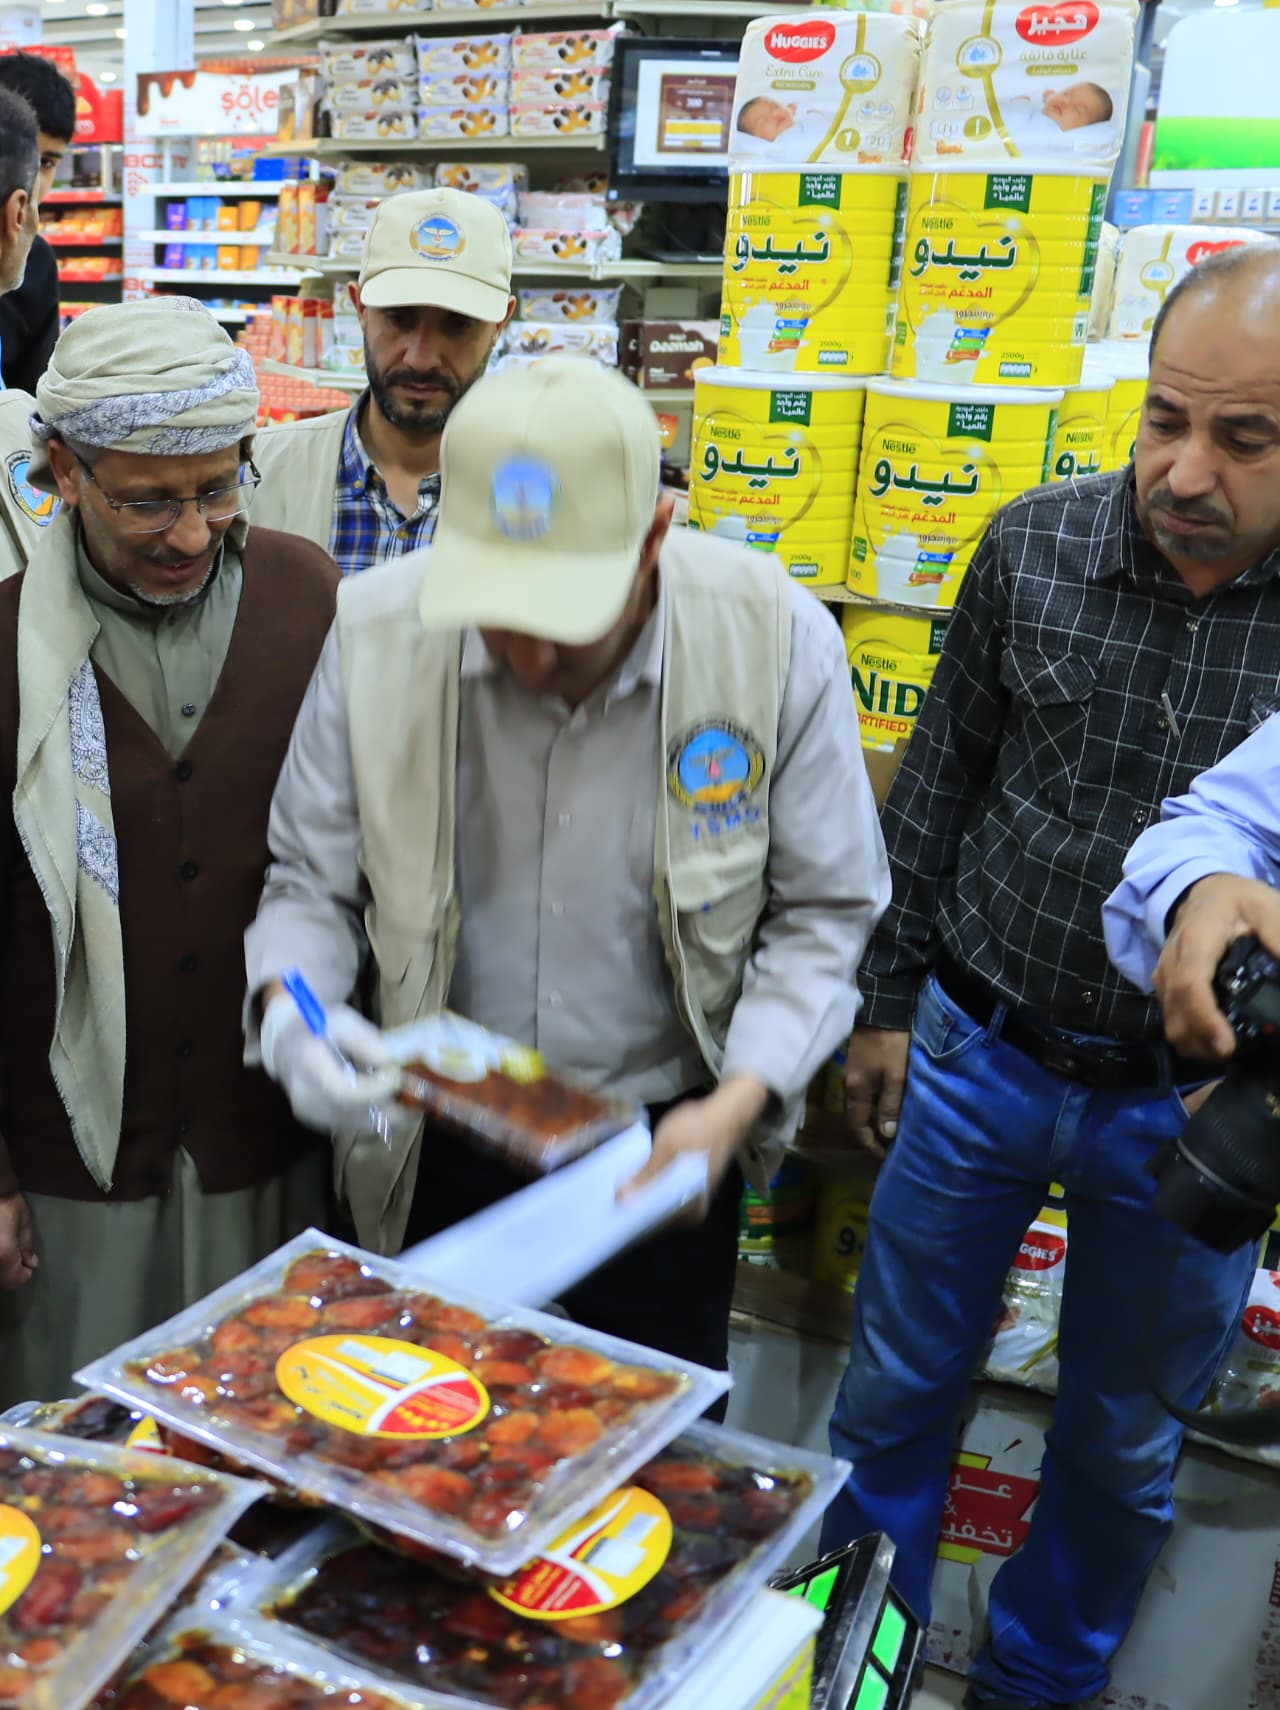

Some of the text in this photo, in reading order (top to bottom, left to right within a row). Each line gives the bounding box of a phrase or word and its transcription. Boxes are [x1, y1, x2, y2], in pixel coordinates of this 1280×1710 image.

[770, 32, 828, 49] HUGGIES
[1027, 13, 1088, 36] هجيز
[765, 65, 795, 78] Extra
[730, 231, 831, 274] نيدو
[909, 234, 1018, 281] نيدو
[699, 447, 801, 489] نيدو
[869, 459, 979, 507] نيدو
